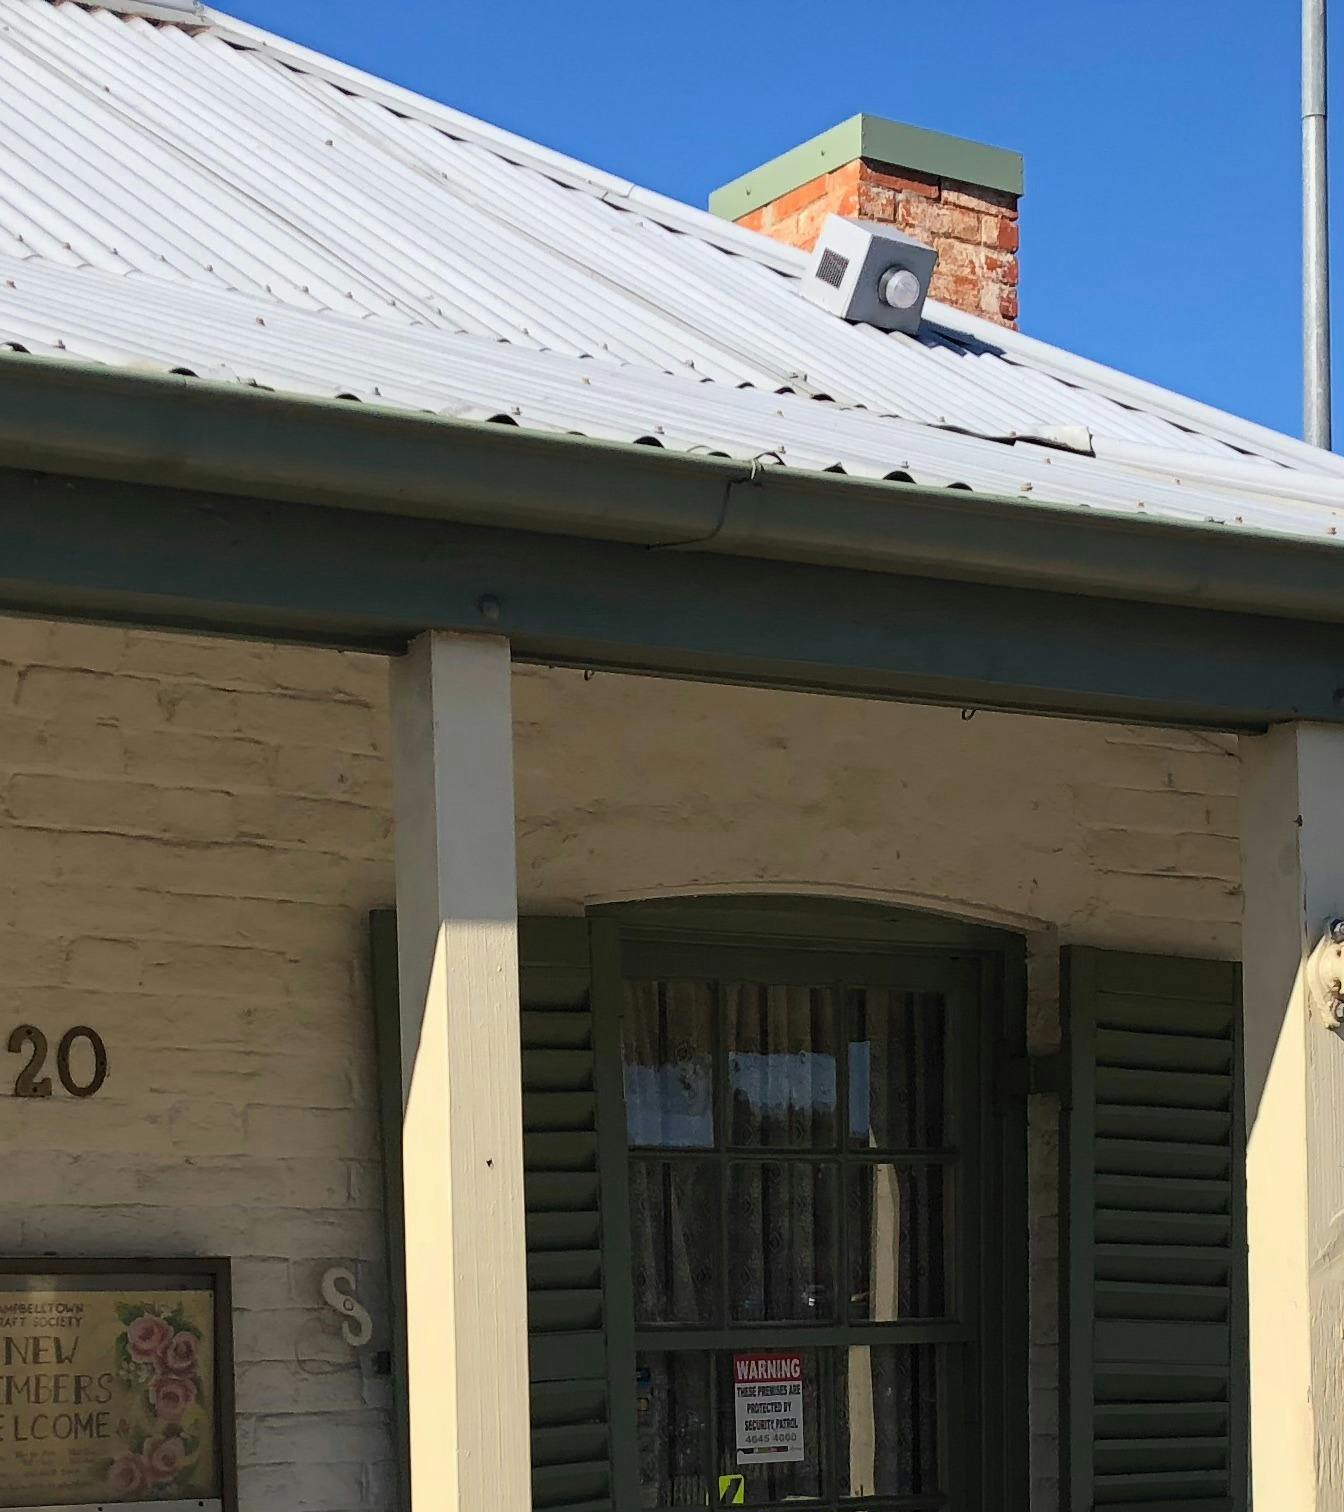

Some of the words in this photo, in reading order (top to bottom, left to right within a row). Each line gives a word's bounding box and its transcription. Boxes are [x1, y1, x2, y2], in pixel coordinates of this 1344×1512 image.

[32, 1316, 83, 1328] SOCIETY
[3, 1335, 80, 1366] NEW
[736, 1358, 800, 1380] WARNING
[737, 1385, 756, 1397] THESE
[757, 1384, 788, 1397] PREMISES
[789, 1384, 801, 1395] ARE
[747, 1401, 782, 1414] PROTECTED
[783, 1401, 792, 1412] BY
[744, 1419, 774, 1431] SECURITY
[775, 1418, 798, 1430] PATROL
